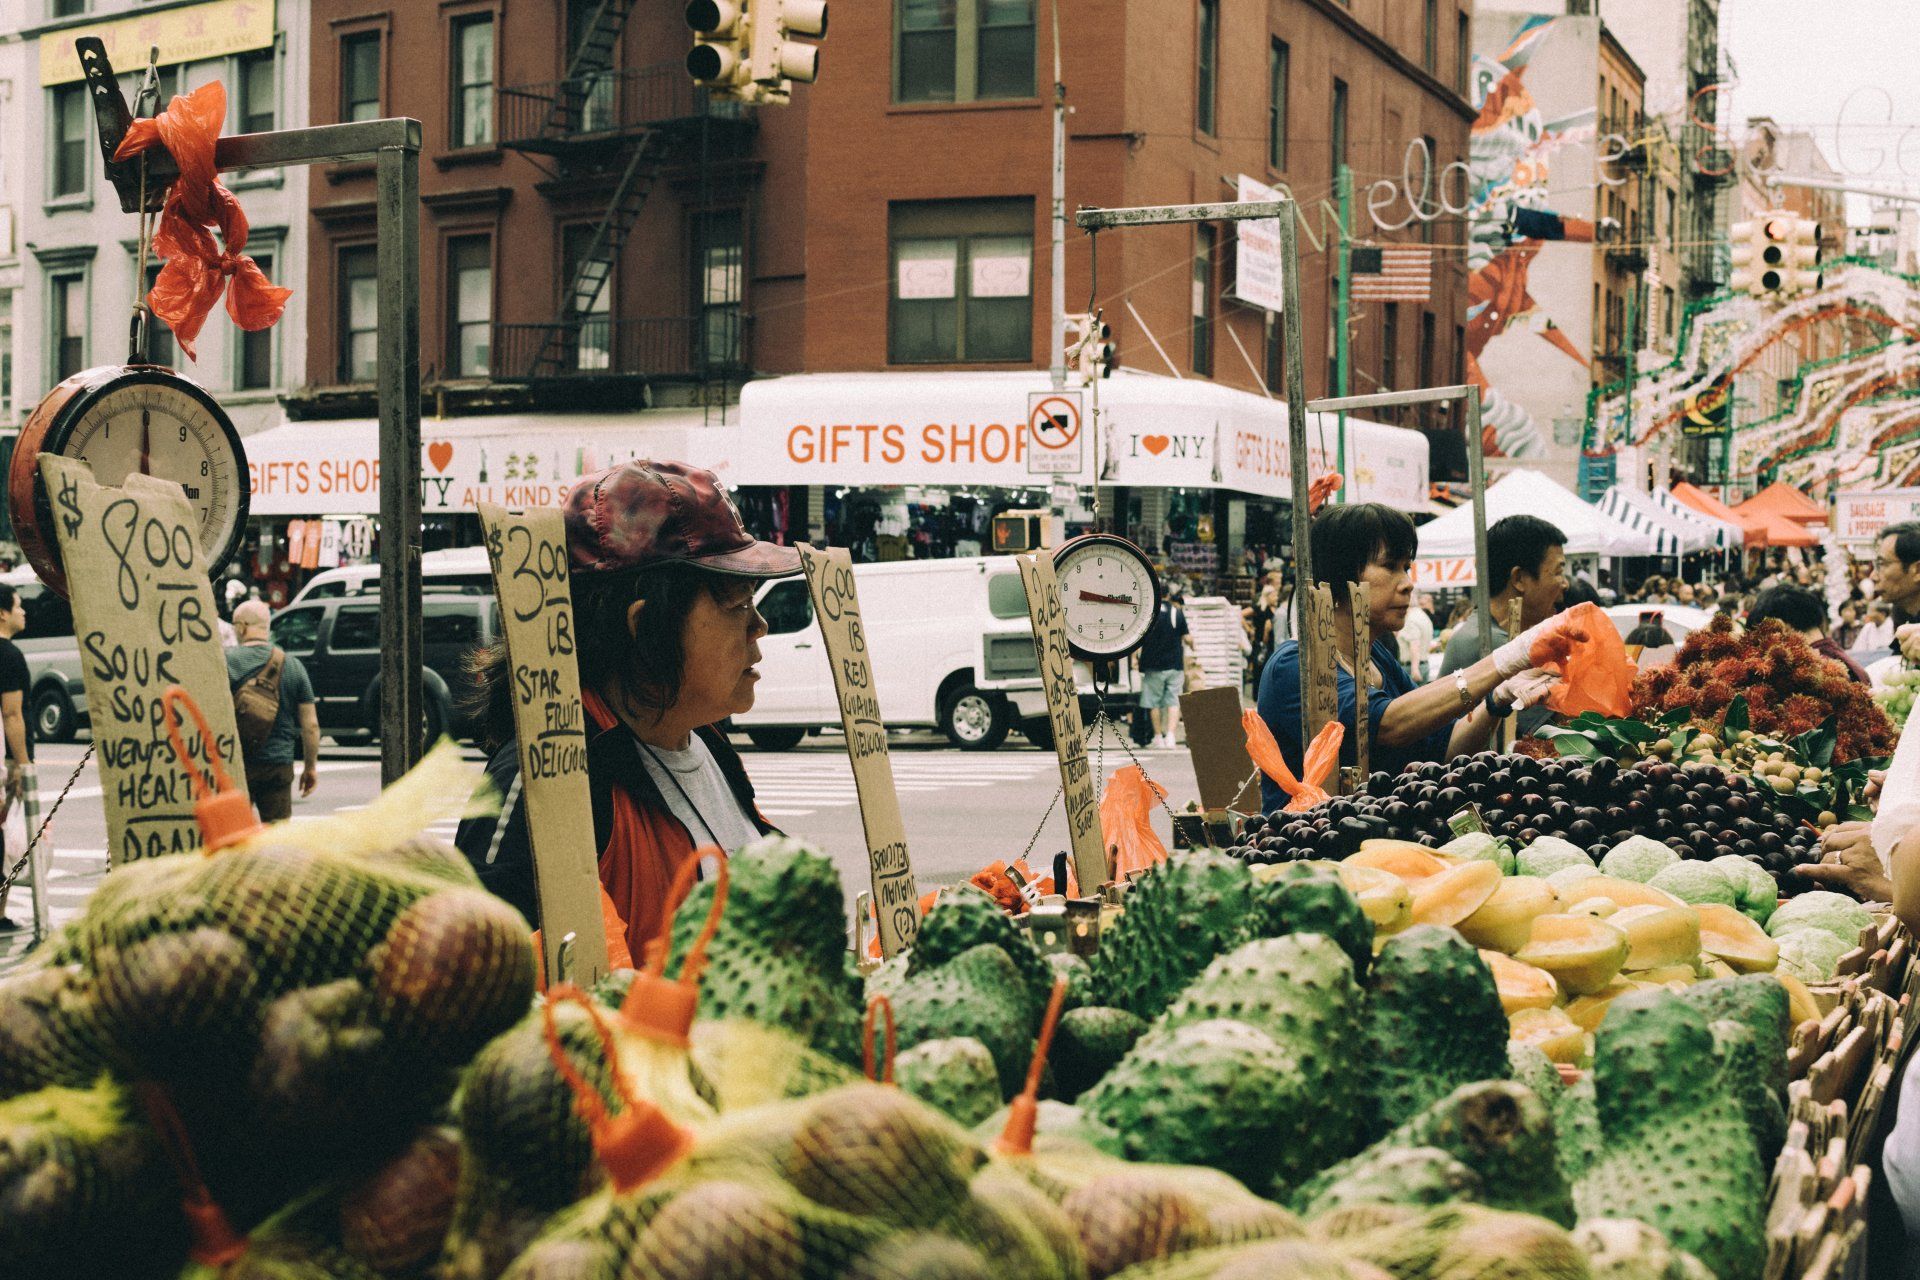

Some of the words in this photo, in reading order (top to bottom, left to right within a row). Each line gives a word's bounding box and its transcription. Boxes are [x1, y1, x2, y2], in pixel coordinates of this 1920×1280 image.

[179, 426, 187, 442] 9
[787, 424, 905, 463] GIFTS
[1130, 434, 1140, 457] I
[1172, 435, 1205, 458] NY
[200, 461, 208, 477] 8
[248, 461, 310, 495] GIFTS
[504, 486, 551, 507] KIND
[201, 508, 207, 524] 7
[1076, 565, 1082, 573] 9
[1097, 557, 1103, 566] 0
[1063, 583, 1069, 591] 8
[1132, 581, 1137, 590] 2
[1132, 606, 1138, 615] 3
[1078, 625, 1083, 633] 6
[1119, 623, 1125, 631] 4
[1099, 631, 1104, 640] 5
[84, 631, 180, 687] SOUR
[843, 658, 868, 689] RED
[516, 665, 561, 705] STAR
